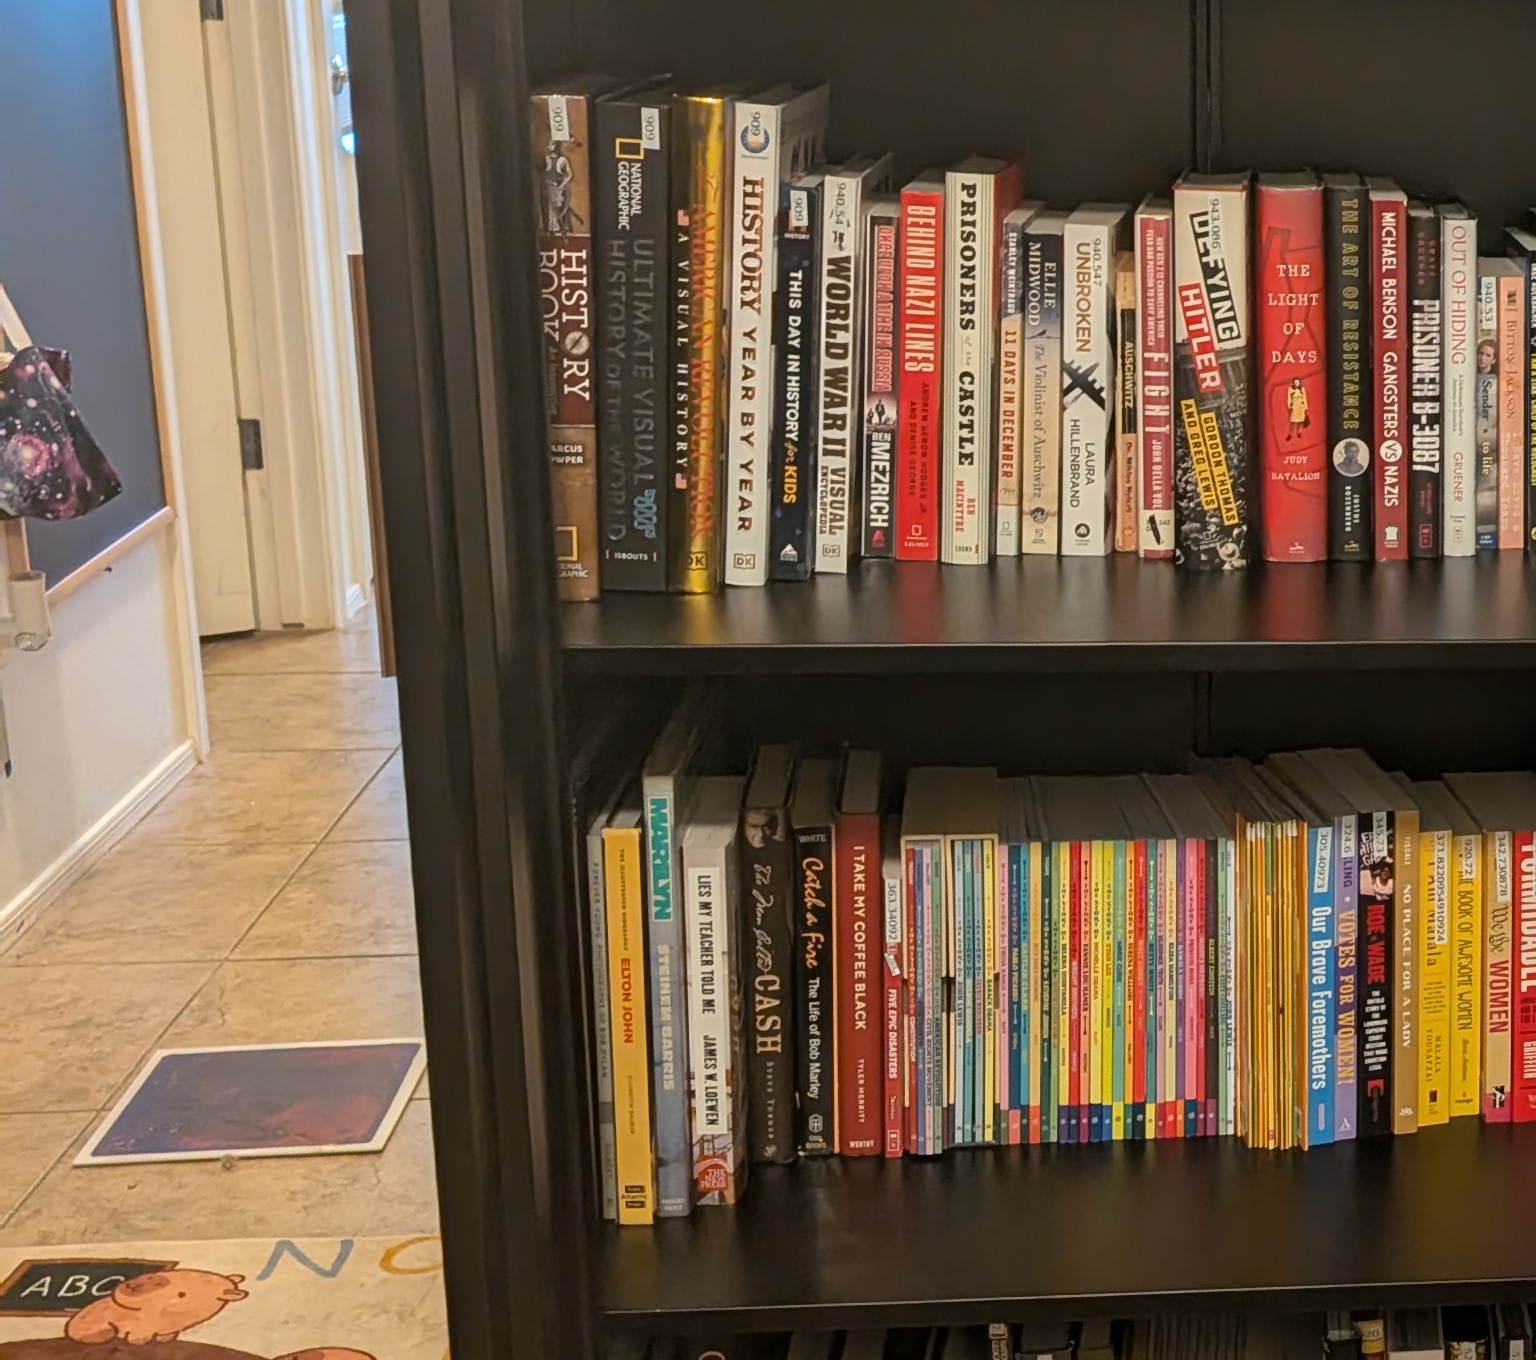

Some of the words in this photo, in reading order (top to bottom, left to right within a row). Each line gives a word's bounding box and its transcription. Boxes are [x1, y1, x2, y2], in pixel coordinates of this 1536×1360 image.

[740, 176, 766, 316] HISTORY
[907, 205, 936, 269] BEHIND
[959, 182, 978, 332] PRISONERS
[1381, 212, 1397, 273] MICHAEL
[1452, 226, 1468, 266] OUT
[1276, 264, 1311, 277] THE
[1452, 273, 1466, 295] OF
[906, 275, 936, 316] NAZI
[1075, 242, 1092, 353] UNBROKEN
[1268, 293, 1319, 306] LIGHT
[1382, 279, 1398, 340] BENSON
[905, 323, 935, 372] LINES
[1181, 288, 1221, 389] HITLER
[1283, 322, 1305, 335] OF
[1451, 302, 1466, 365] HIDING
[737, 327, 757, 402] YEAR
[1272, 351, 1317, 364] DAYS
[1383, 351, 1399, 438] GANGSTERS
[737, 412, 756, 448] BY
[958, 371, 976, 467] CASTLE
[1069, 418, 1081, 509] HILLENBRAND
[1084, 442, 1095, 487] LAURA
[1384, 465, 1399, 508] NAZIS
[736, 455, 755, 532] YEAR
[854, 851, 865, 892] TAKE
[854, 896, 865, 918] MY
[1312, 906, 1329, 934] Our
[854, 921, 866, 979] COFFEE
[1312, 937, 1330, 985] Brave
[621, 957, 632, 1002] ELTON
[622, 1005, 634, 1045] JOHN
[754, 973, 782, 1055] CASH
[854, 983, 866, 1030] BLACK
[1312, 988, 1331, 1090] Foremothers
[256, 1238, 353, 1280] N
[21, 1274, 126, 1298] ABC
